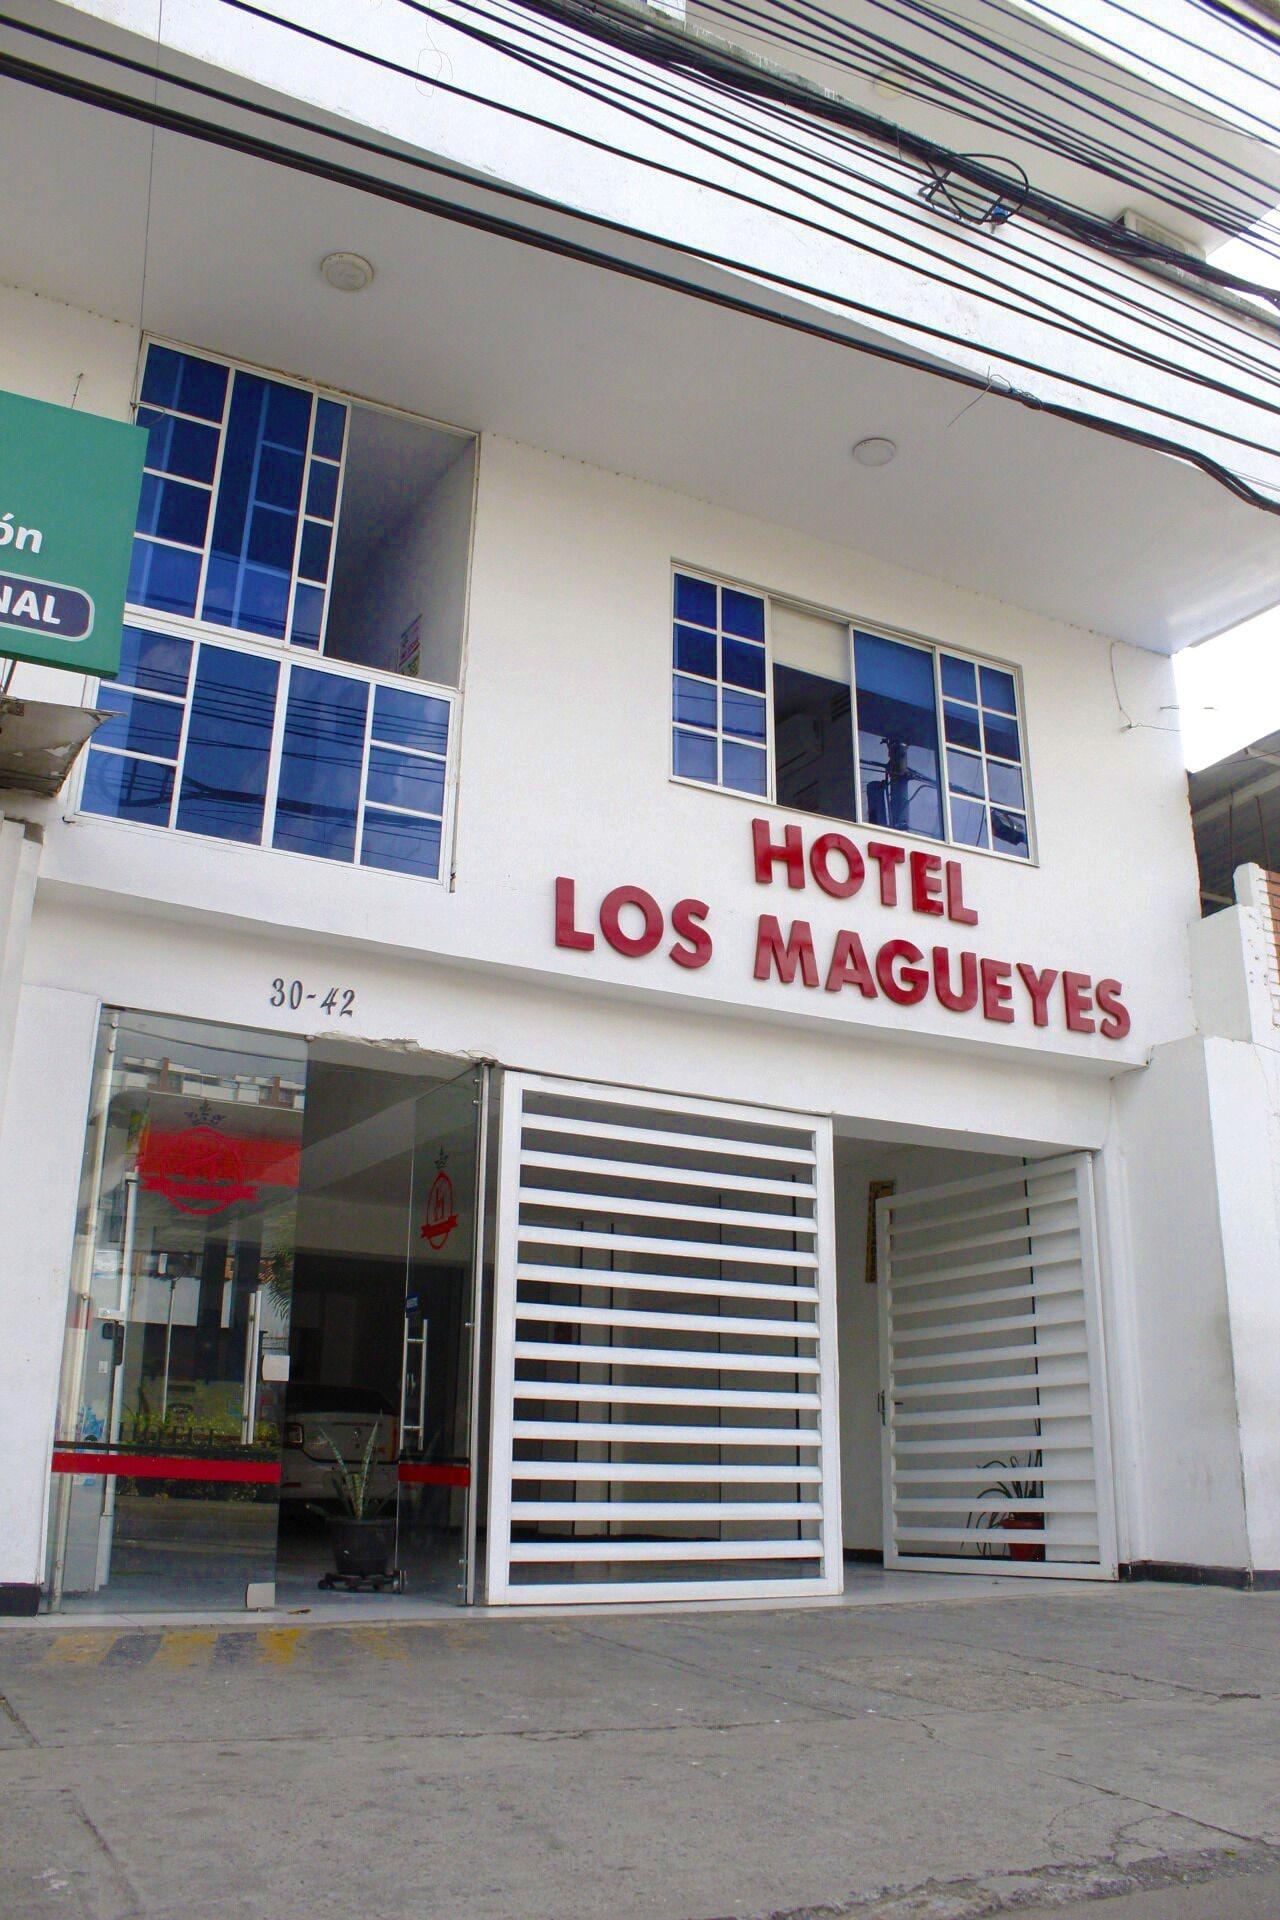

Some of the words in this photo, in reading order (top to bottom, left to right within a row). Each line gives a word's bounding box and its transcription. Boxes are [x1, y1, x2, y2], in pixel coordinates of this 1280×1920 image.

[752, 818, 978, 925] HOTEL
[270, 977, 355, 1017] 30-42
[555, 876, 713, 969] LOS
[753, 914, 1131, 1039] MAGUEYES
